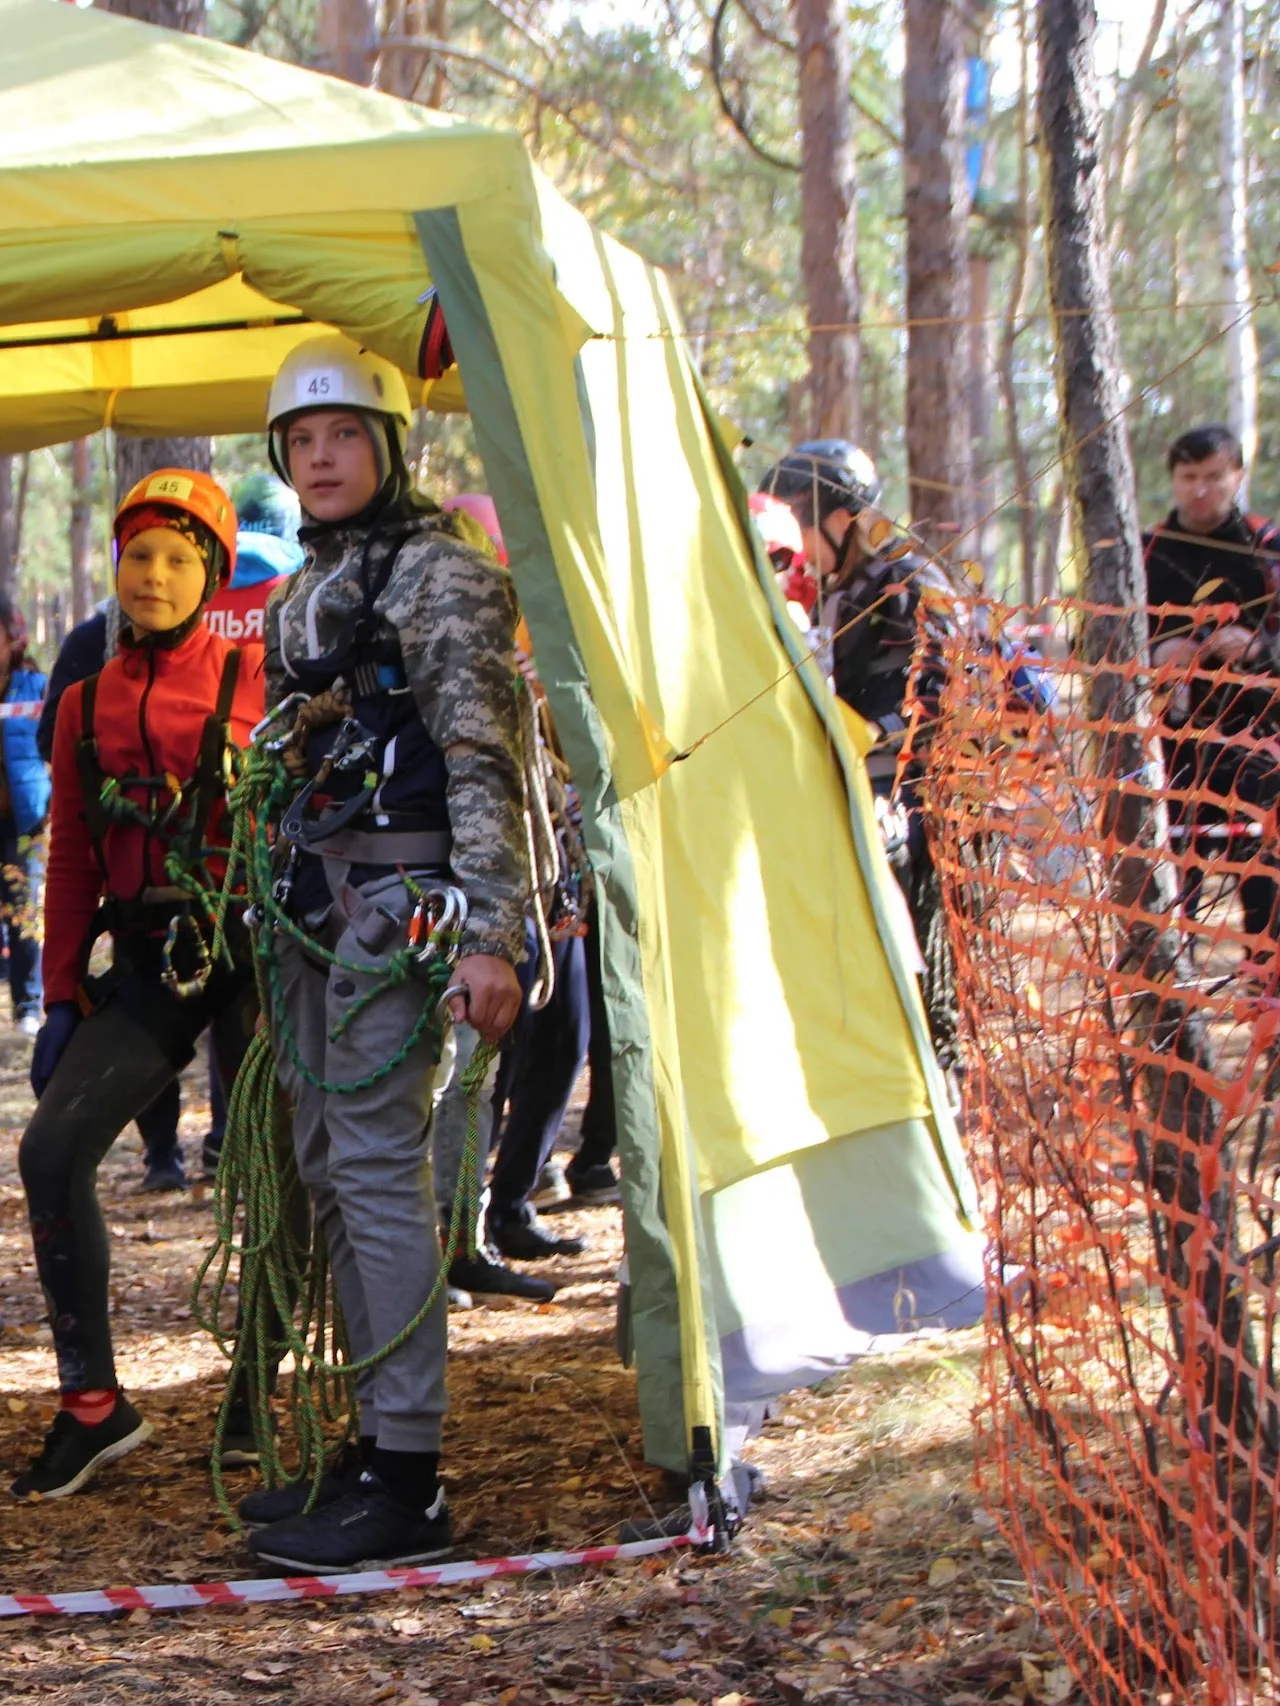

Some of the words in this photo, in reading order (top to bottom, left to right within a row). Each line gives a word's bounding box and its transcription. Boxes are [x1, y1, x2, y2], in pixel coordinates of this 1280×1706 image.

[308, 376, 330, 395] 45
[158, 480, 180, 493] 45
[203, 608, 265, 640] ДЬЯ
